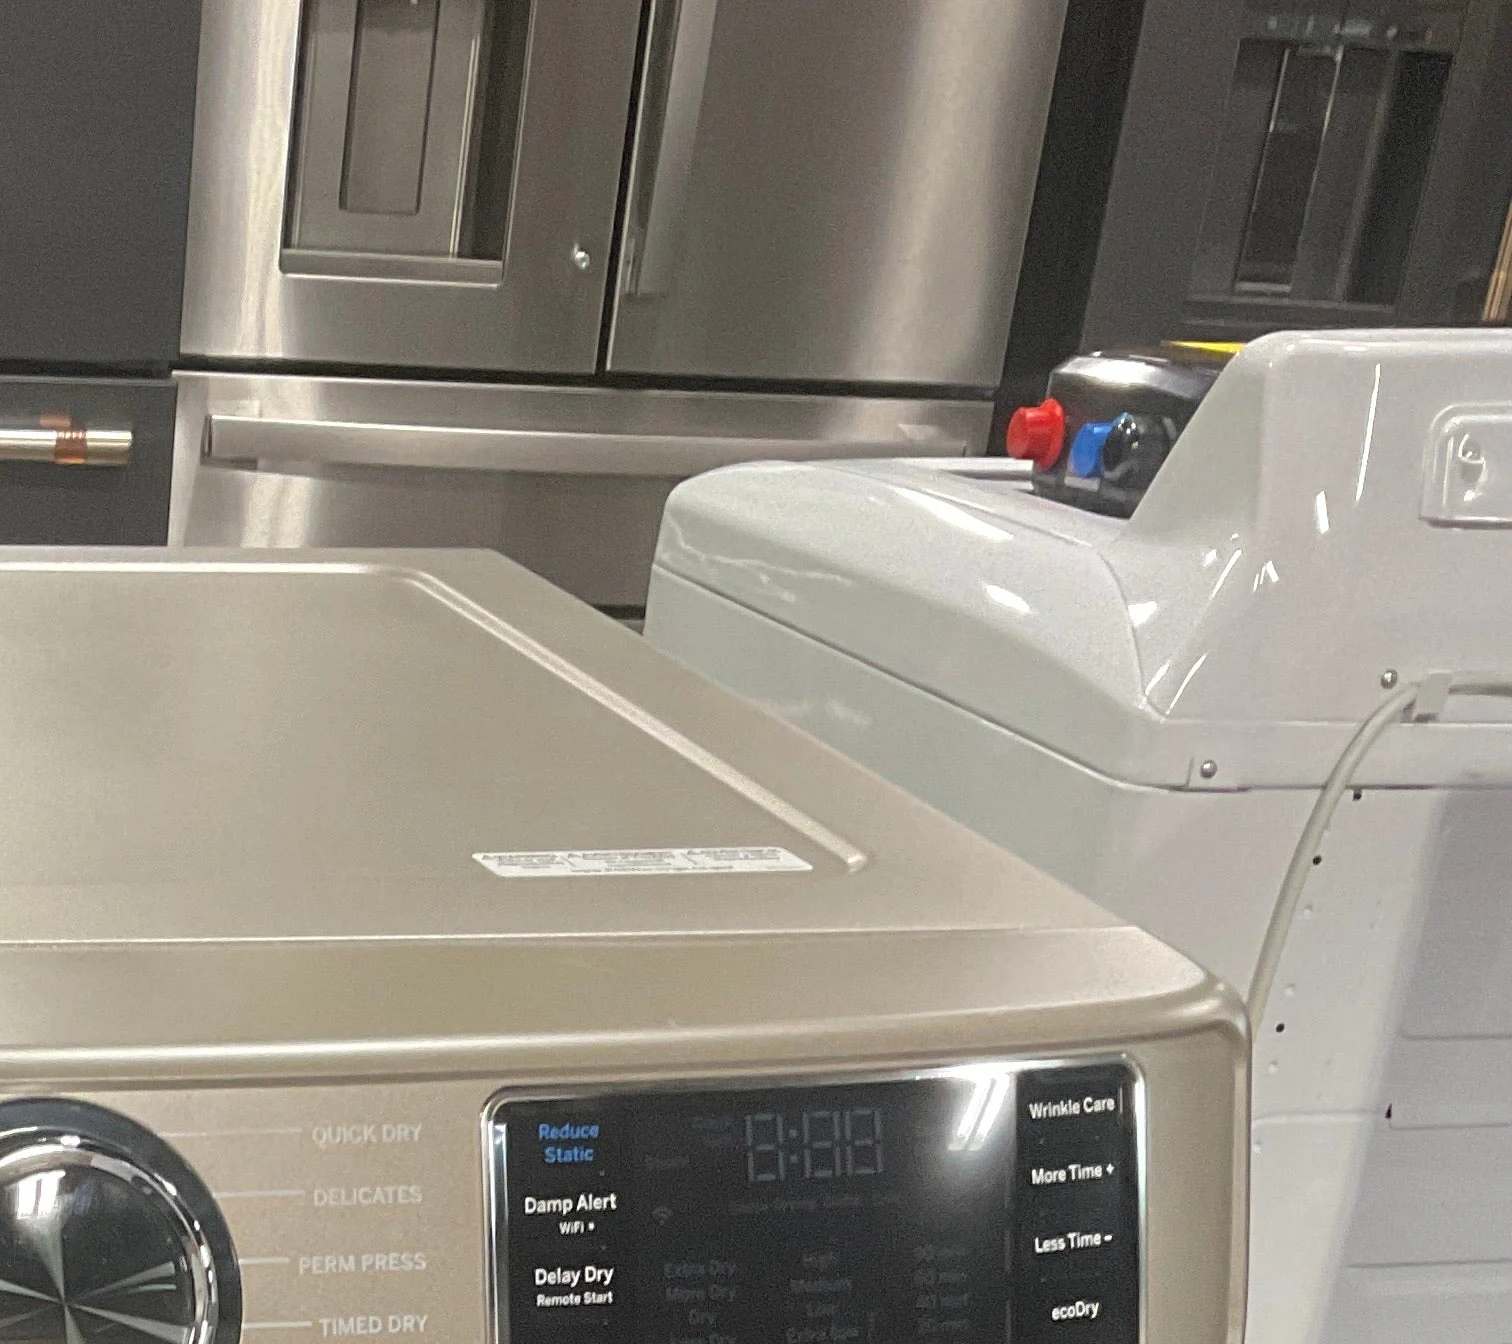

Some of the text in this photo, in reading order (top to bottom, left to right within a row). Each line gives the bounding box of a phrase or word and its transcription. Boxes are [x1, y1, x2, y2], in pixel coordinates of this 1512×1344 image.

[1029, 1096, 1115, 1119] Wrinkle Care
[312, 1123, 422, 1150] QUICK DRY
[539, 1123, 599, 1140] Reduce
[545, 1146, 593, 1163] Static
[1031, 1168, 1066, 1185] More
[1068, 1164, 1103, 1181] Time
[314, 1185, 422, 1206] DELICATES
[525, 1192, 617, 1216] Damp Alert
[559, 1221, 584, 1234] WiFi
[1035, 1237, 1066, 1254] Less
[1067, 1232, 1102, 1250] Time
[299, 1252, 426, 1274] PERM PRESS
[535, 1265, 614, 1287] Delay Dry
[537, 1291, 613, 1307] Remote Start
[1051, 1300, 1099, 1320] ecoDry
[320, 1315, 428, 1336] TIMED DRY
